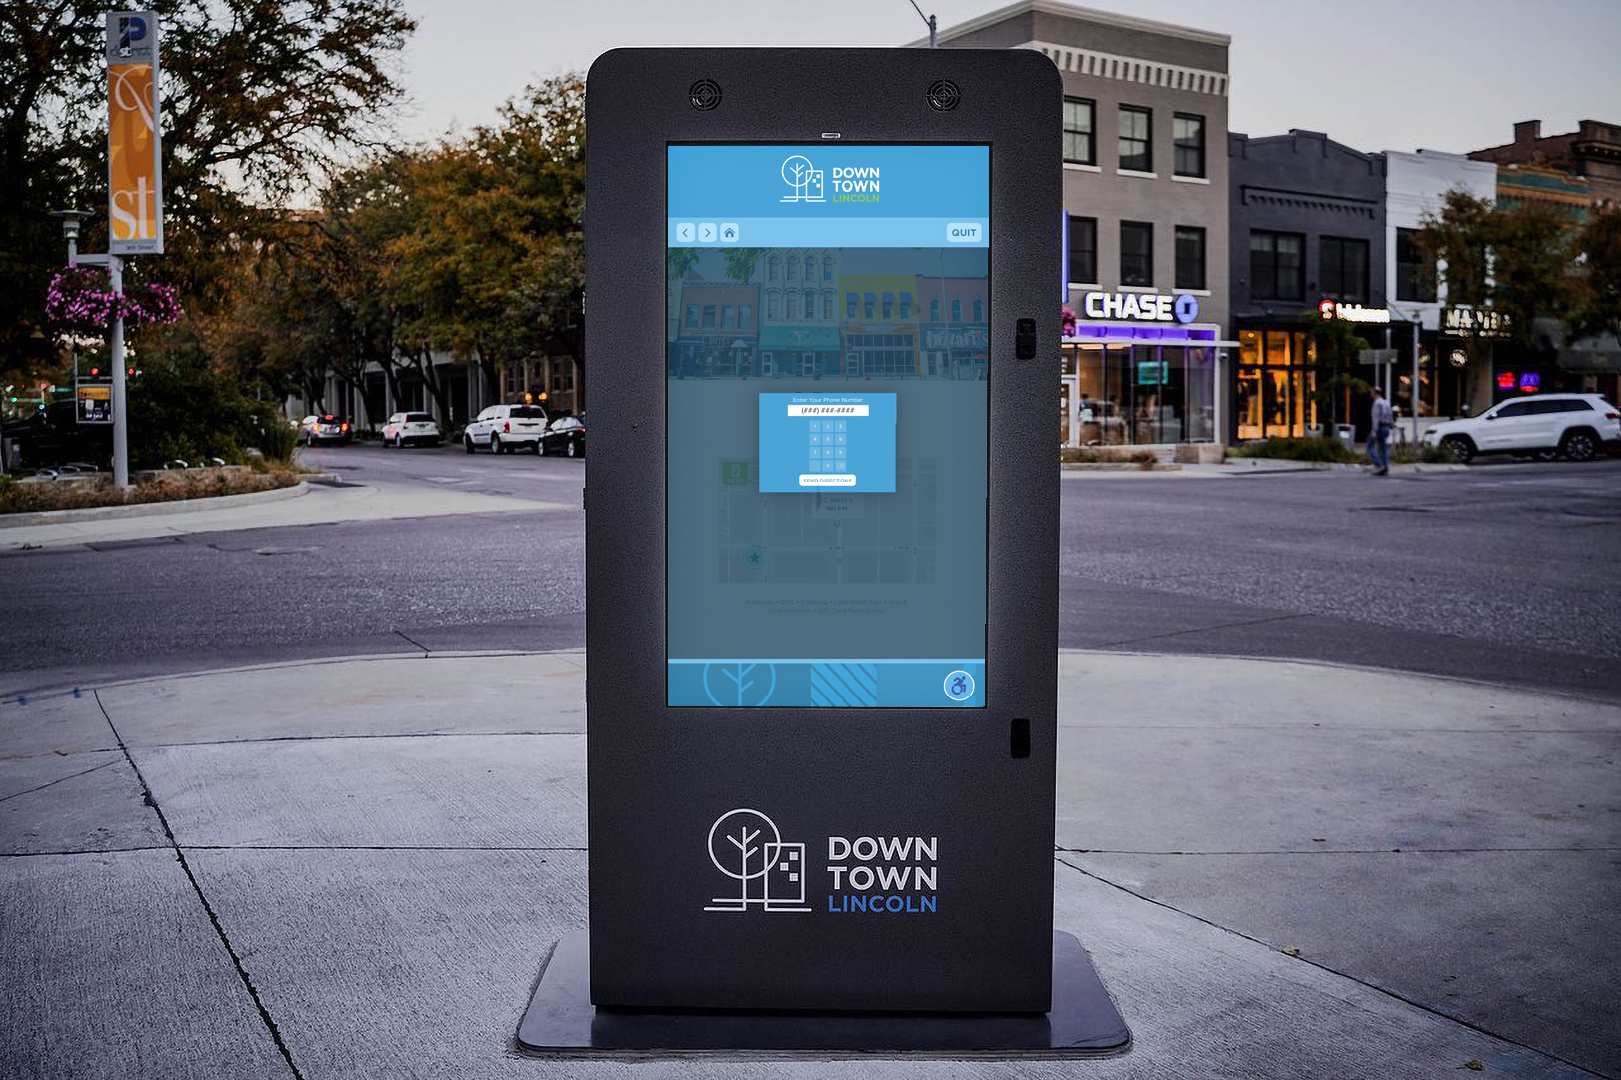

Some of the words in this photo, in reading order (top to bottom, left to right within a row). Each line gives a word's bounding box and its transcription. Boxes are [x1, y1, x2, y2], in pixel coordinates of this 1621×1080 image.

[833, 167, 880, 178] DOWN
[832, 180, 880, 192] TOWN
[833, 194, 880, 202] LINCOLN
[952, 229, 977, 237] QUIT
[1085, 291, 1174, 321] CHASE
[828, 836, 938, 861] DOWN
[827, 866, 938, 890] TOWN
[828, 895, 937, 913] LINCOLN
